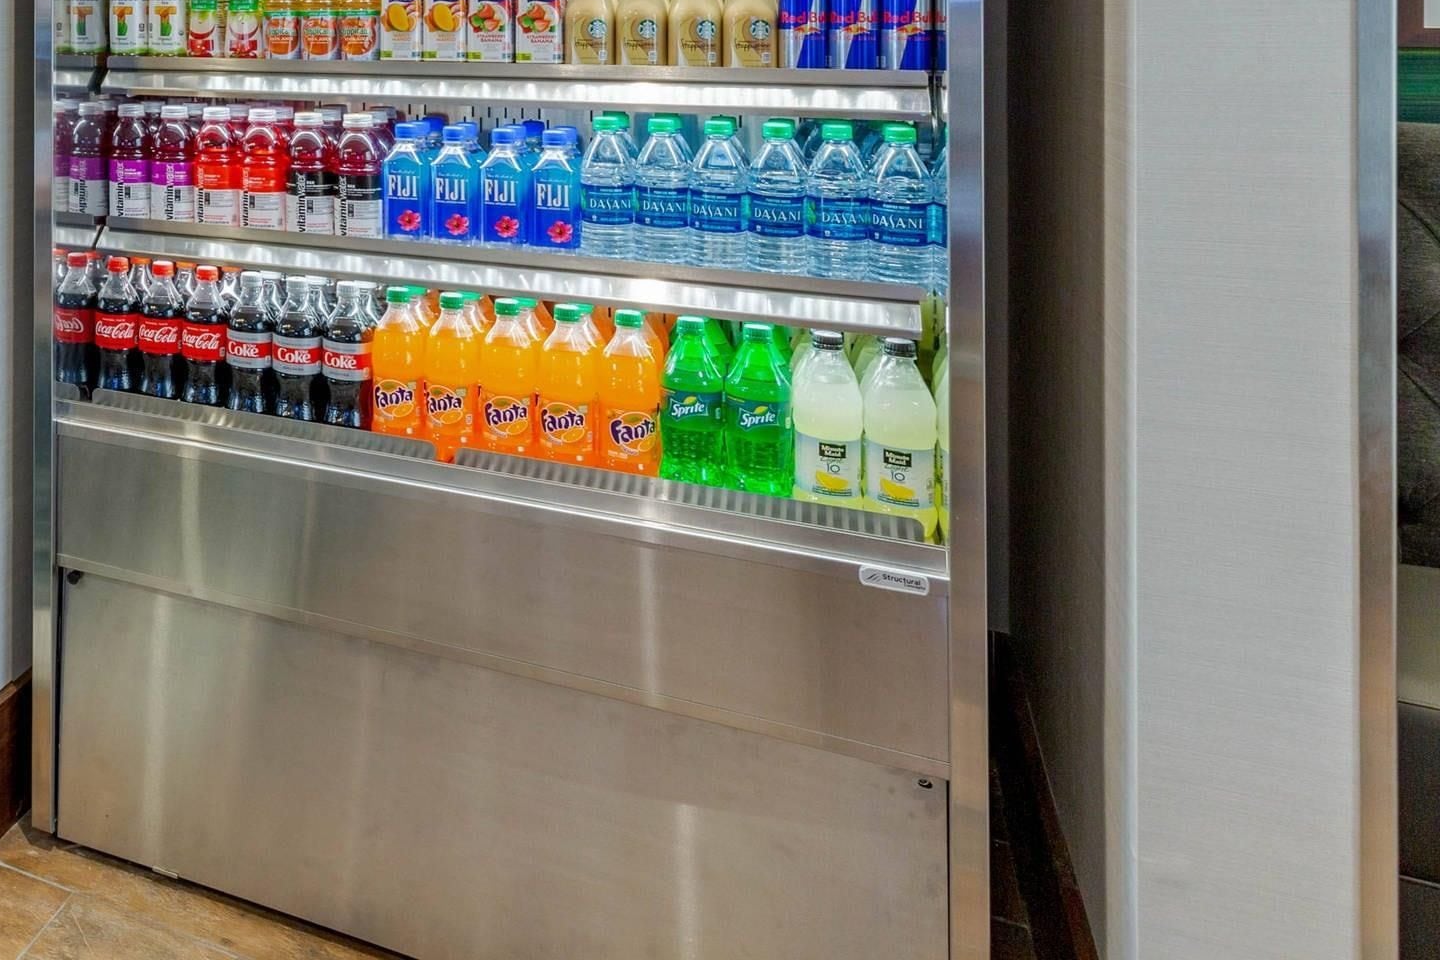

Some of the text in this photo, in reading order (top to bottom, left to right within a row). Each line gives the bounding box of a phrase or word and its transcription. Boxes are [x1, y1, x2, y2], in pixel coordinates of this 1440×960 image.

[781, 11, 806, 24] Red
[883, 11, 907, 24] Red
[388, 175, 418, 197] FIJI
[435, 178, 466, 201] FIJI
[484, 179, 516, 203] FIJI
[536, 183, 569, 208] FIJI
[590, 198, 632, 210] DASANI
[643, 200, 686, 214] DASANI
[693, 203, 738, 218] DASANI
[754, 207, 801, 223] DASANI
[822, 212, 865, 225] DASAN
[872, 213, 923, 230] DASANI
[95, 320, 135, 339] Coca-Cola
[138, 324, 178, 343] Coca-Cola
[181, 329, 221, 350] Coca-Cola
[228, 341, 259, 358] Coke
[277, 347, 312, 364] Coke
[324, 351, 358, 369] Coke
[484, 402, 528, 426] Fanta
[671, 402, 706, 418] Sprite
[541, 408, 584, 433] Fanta
[740, 410, 776, 428] Sprite
[610, 419, 656, 445] Fanta
[885, 451, 910, 461] Minute
[888, 456, 907, 465] Maid
[826, 462, 841, 473] 10
[891, 470, 906, 482] 10
[881, 573, 921, 586] Structural
